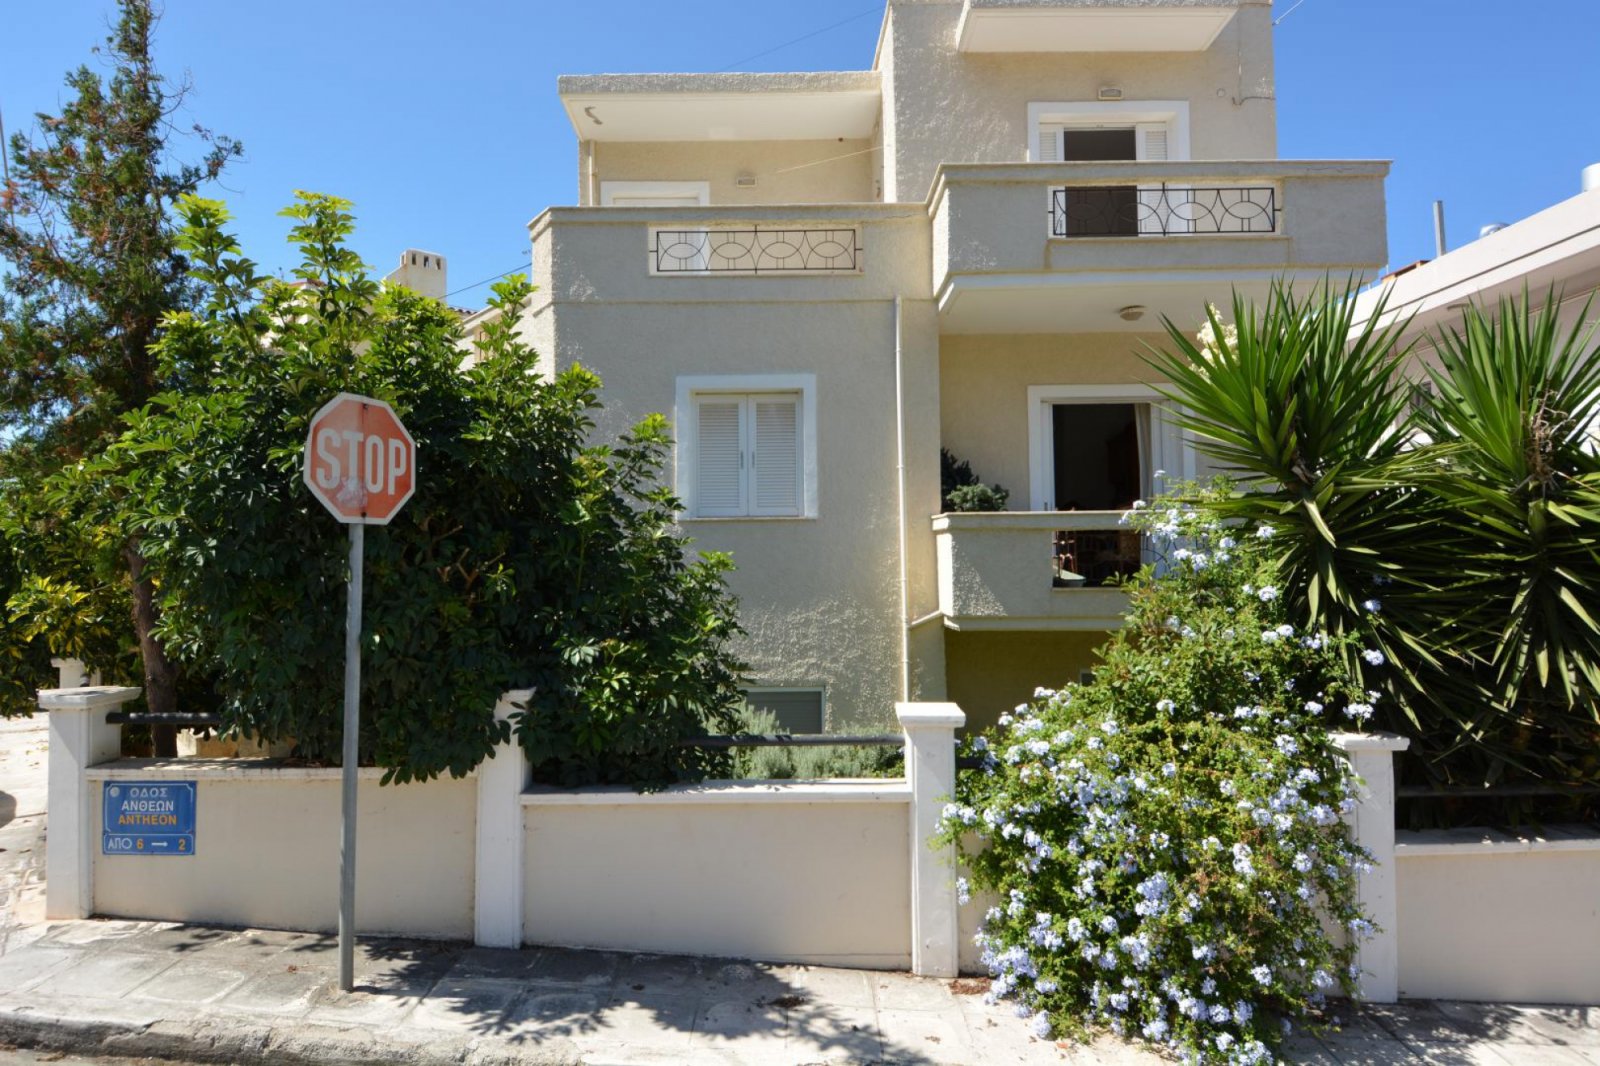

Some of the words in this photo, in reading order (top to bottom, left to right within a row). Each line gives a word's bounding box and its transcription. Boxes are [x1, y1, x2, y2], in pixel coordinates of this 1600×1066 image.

[316, 428, 407, 496] STOP
[130, 787, 168, 798] ΟΔΟΣ
[121, 800, 174, 812] ΑΝΘΕΩΝ
[118, 814, 177, 825] ANTHEON
[107, 837, 133, 850] ΑΠΟ
[136, 838, 144, 850] 6
[178, 838, 186, 851] 2
